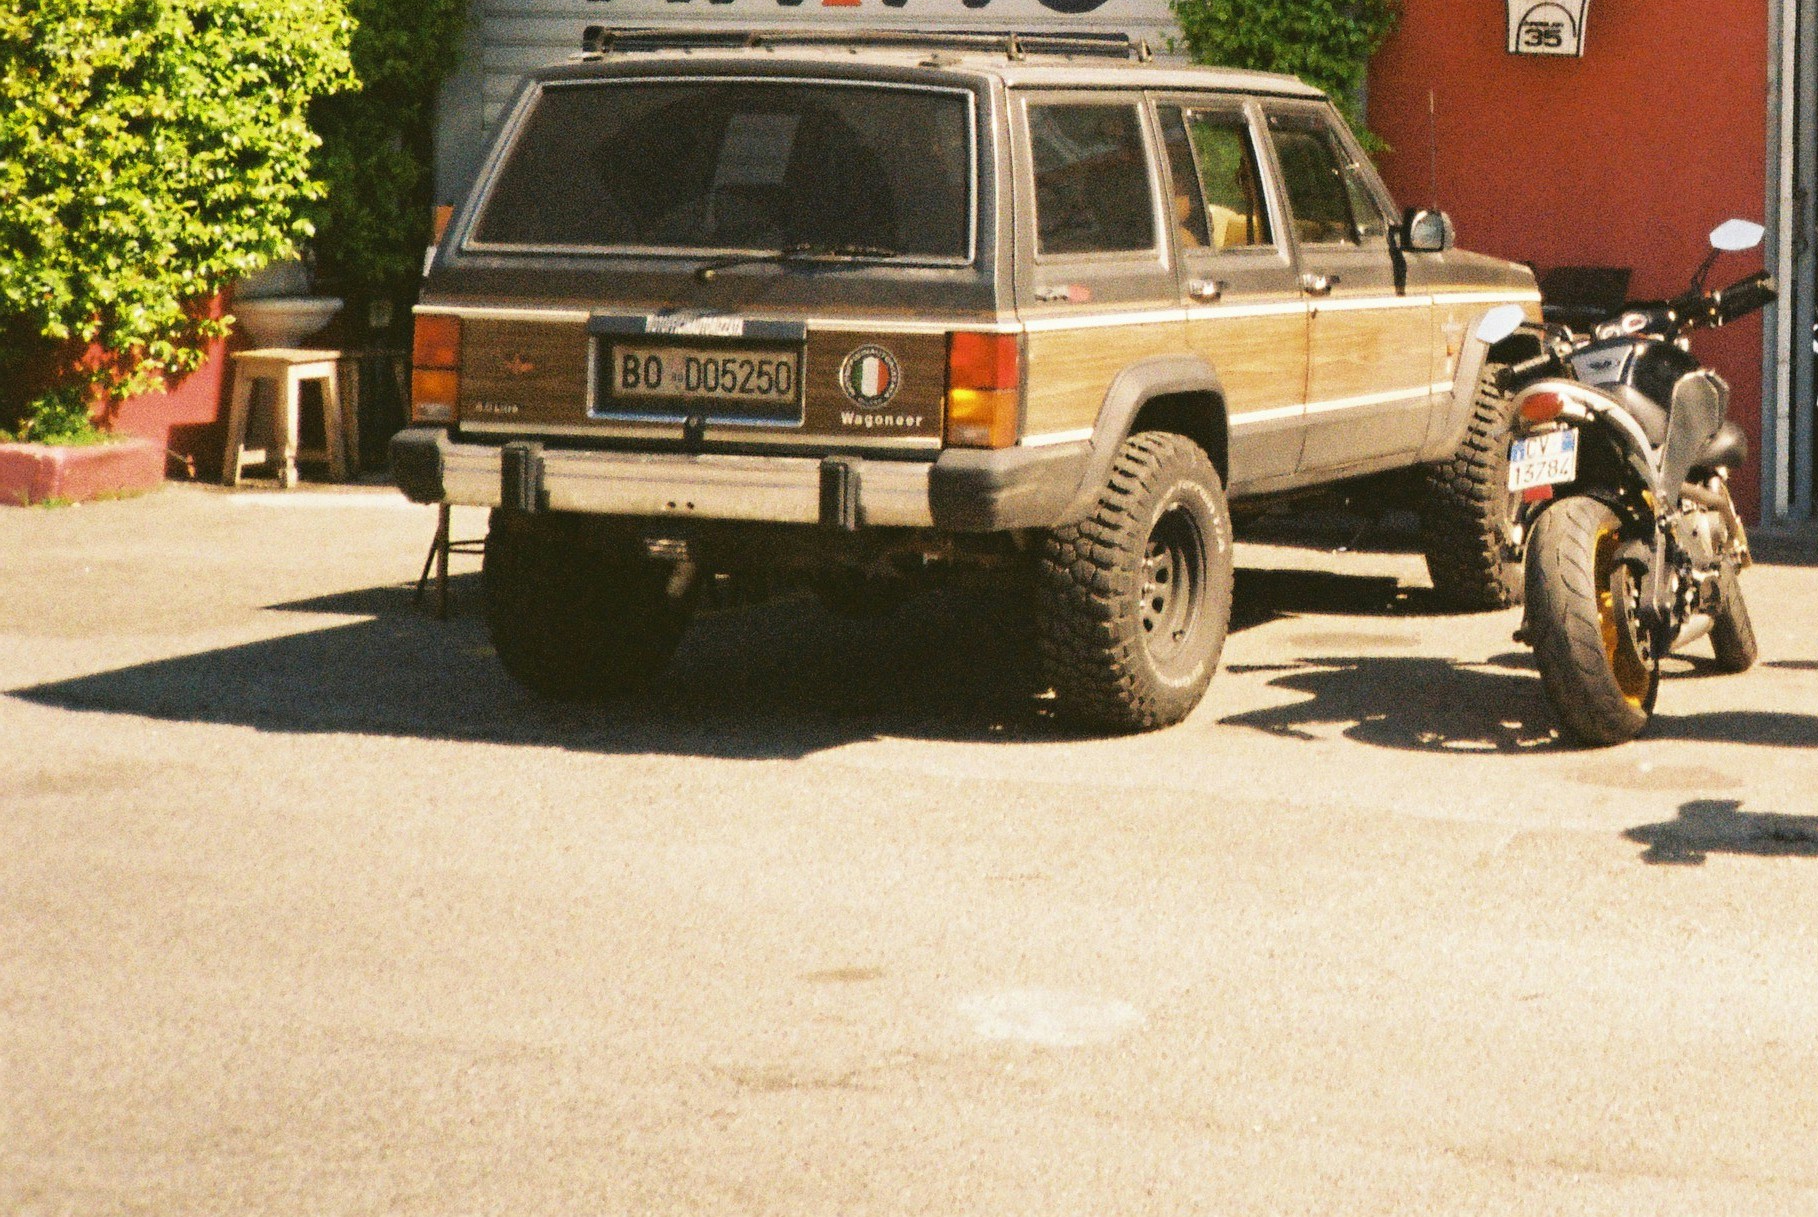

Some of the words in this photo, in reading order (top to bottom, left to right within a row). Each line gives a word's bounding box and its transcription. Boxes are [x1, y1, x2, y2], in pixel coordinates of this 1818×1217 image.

[1524, 27, 1563, 48] 35
[621, 353, 663, 390] BO
[840, 411, 924, 428] Wagoneer
